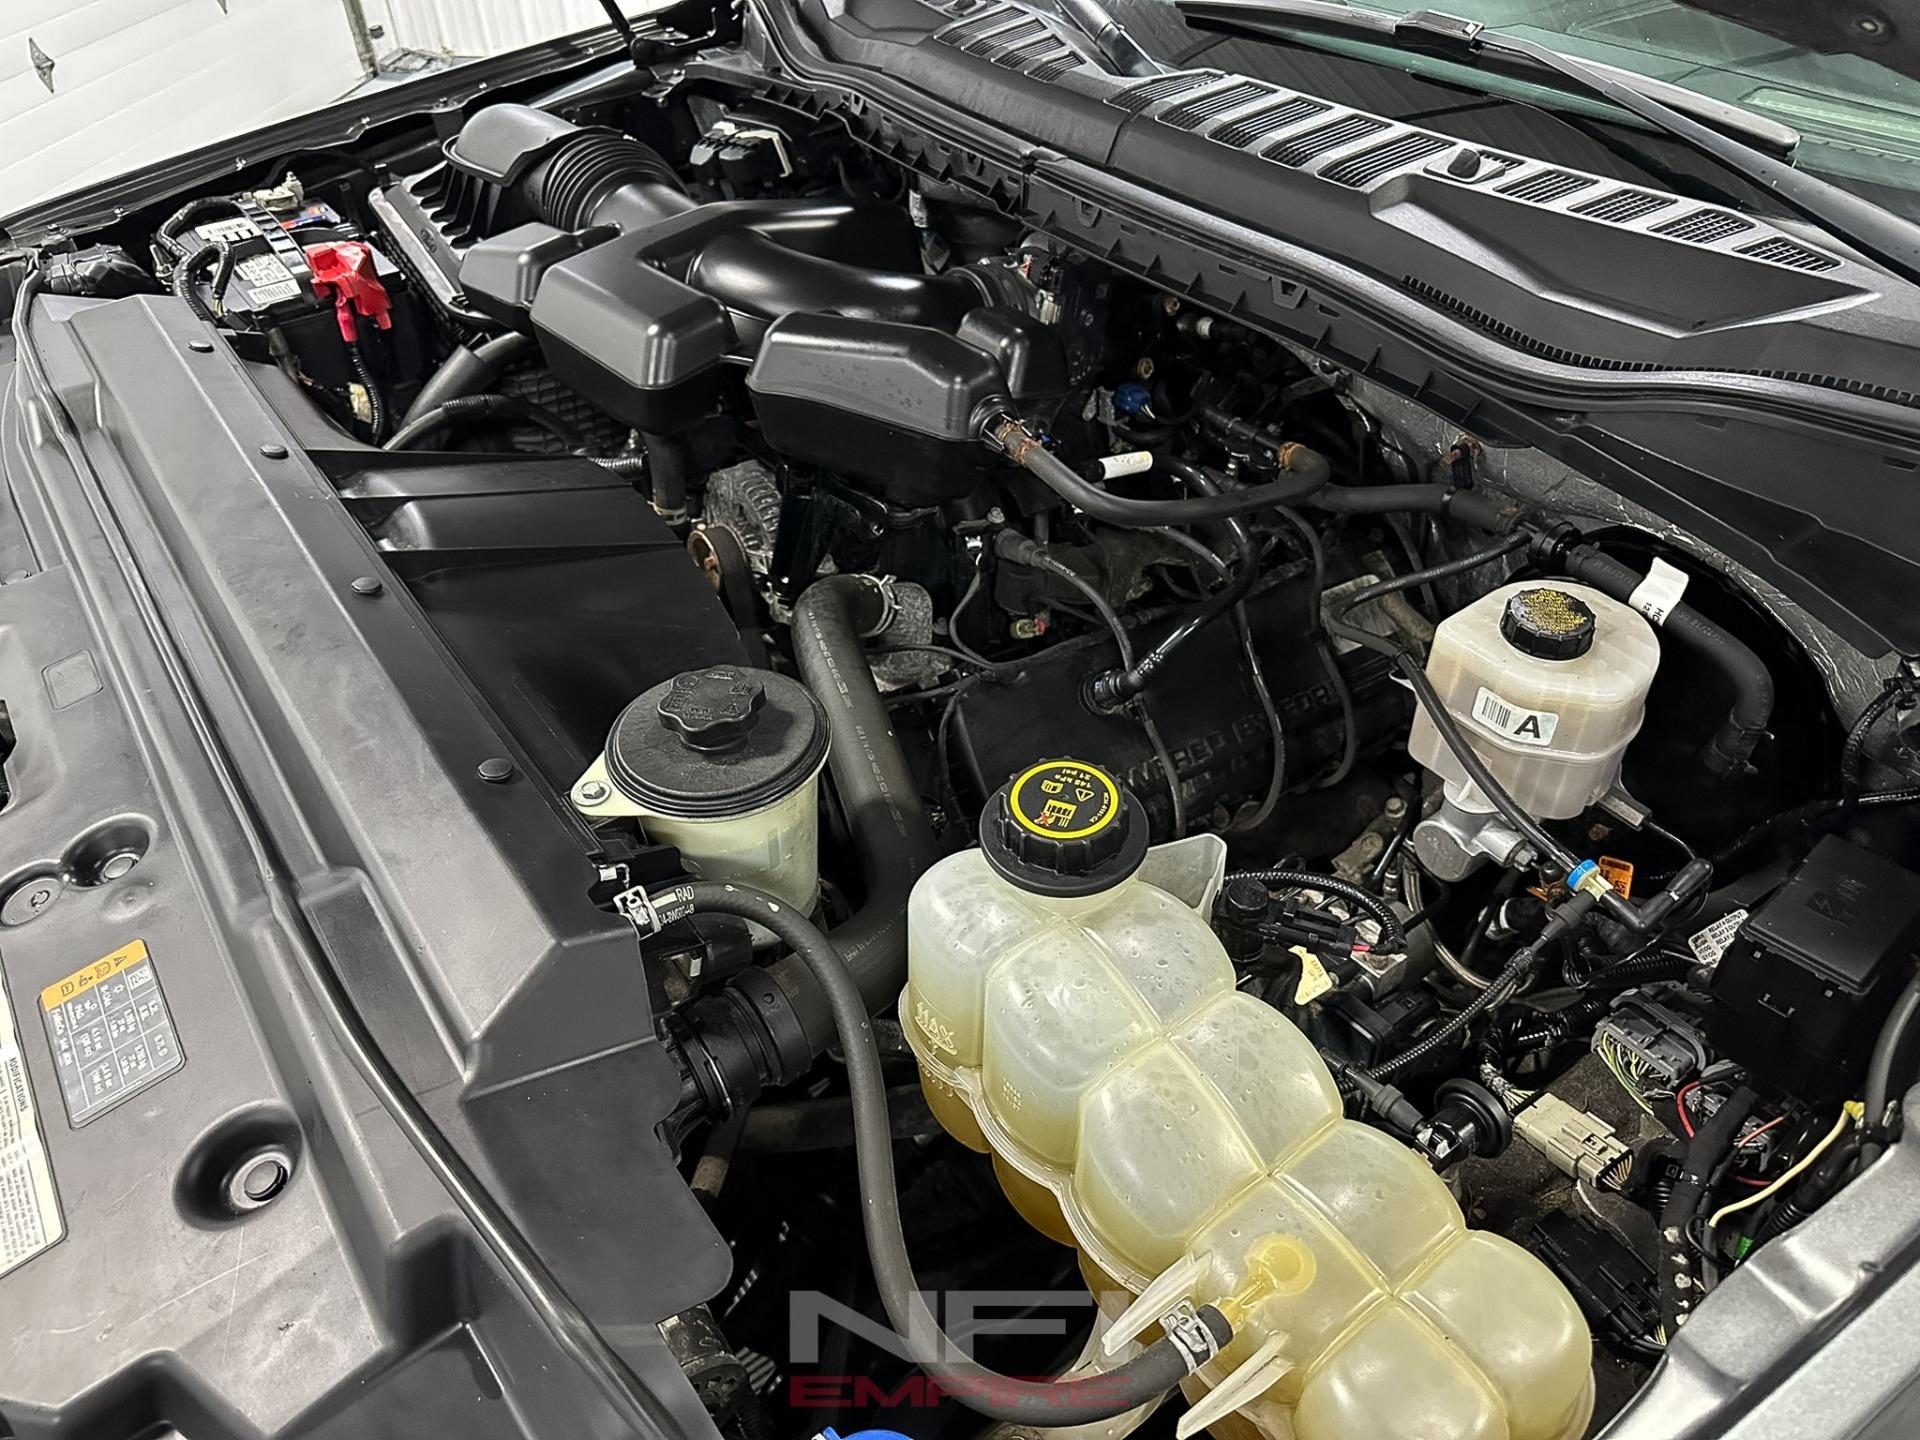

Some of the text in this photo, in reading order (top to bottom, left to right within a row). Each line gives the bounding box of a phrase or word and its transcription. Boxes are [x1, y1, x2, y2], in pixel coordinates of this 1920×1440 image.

[1513, 715, 1541, 739] A
[675, 885, 695, 902] RAD
[917, 1001, 955, 1051] MAX
